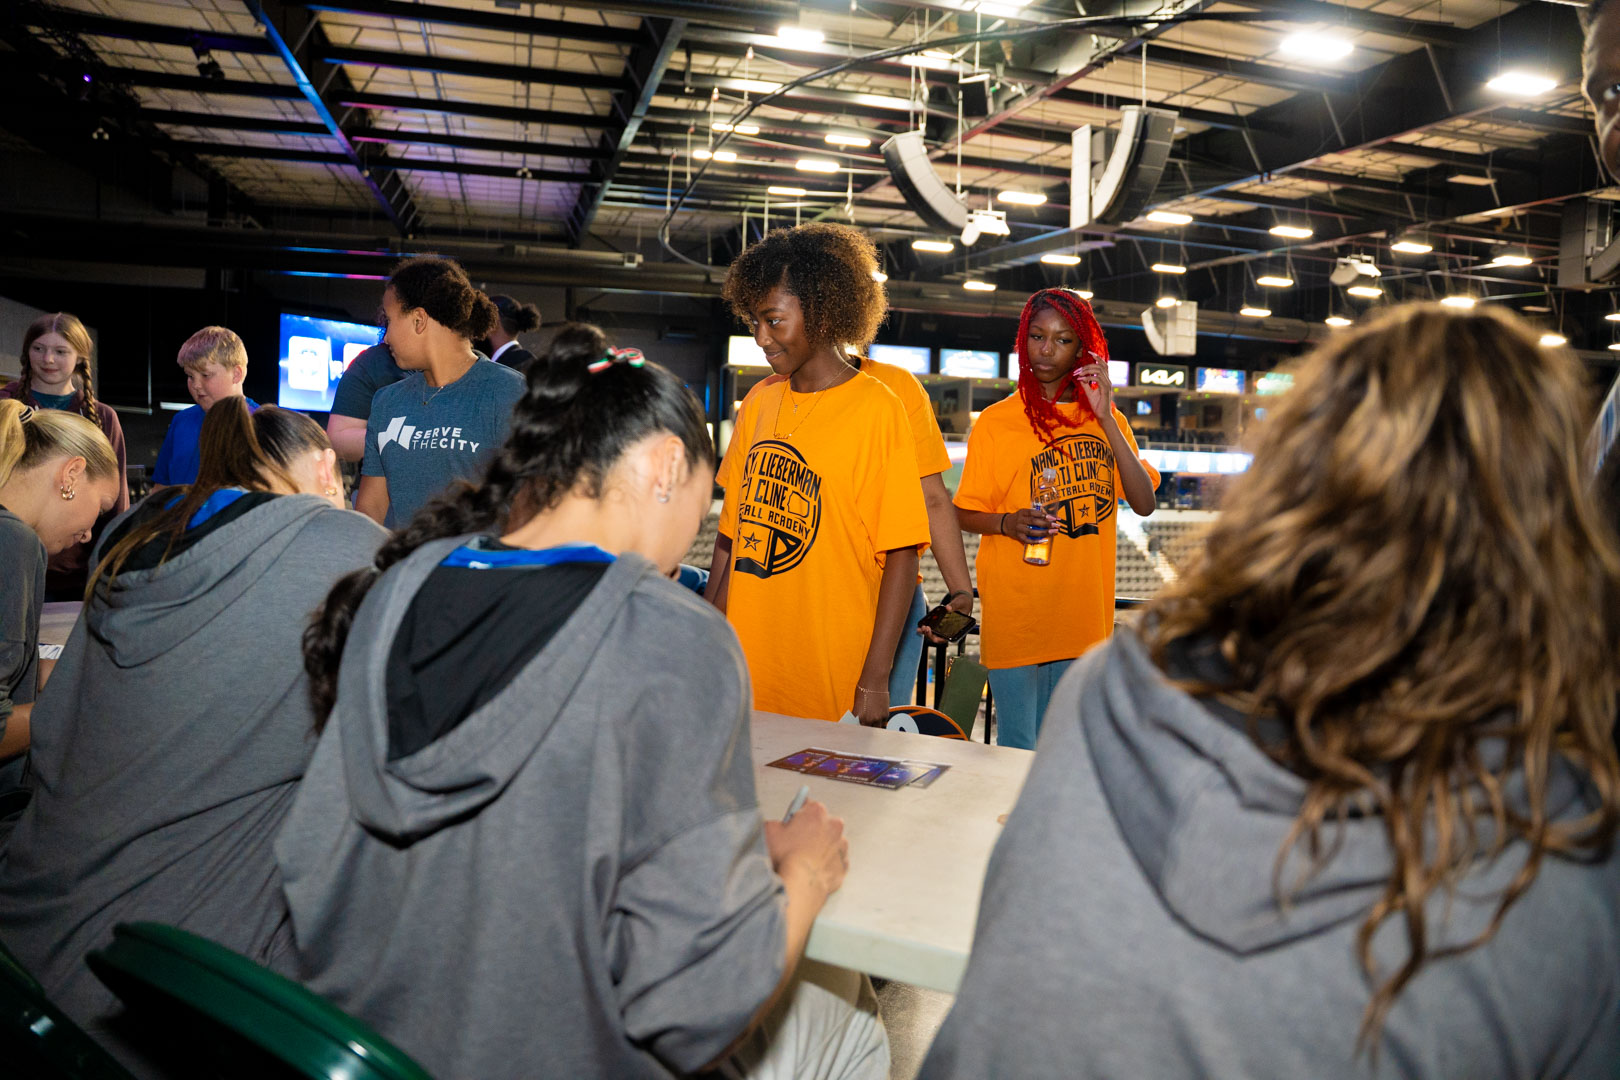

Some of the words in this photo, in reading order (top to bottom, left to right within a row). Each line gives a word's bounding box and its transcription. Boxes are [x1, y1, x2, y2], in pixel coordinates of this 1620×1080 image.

[413, 426, 463, 439] SERVE
[1031, 445, 1064, 476] NANCY
[758, 452, 822, 501] LIEBERMAN
[754, 478, 788, 511] CLINE
[768, 510, 811, 539] ACADEMY
